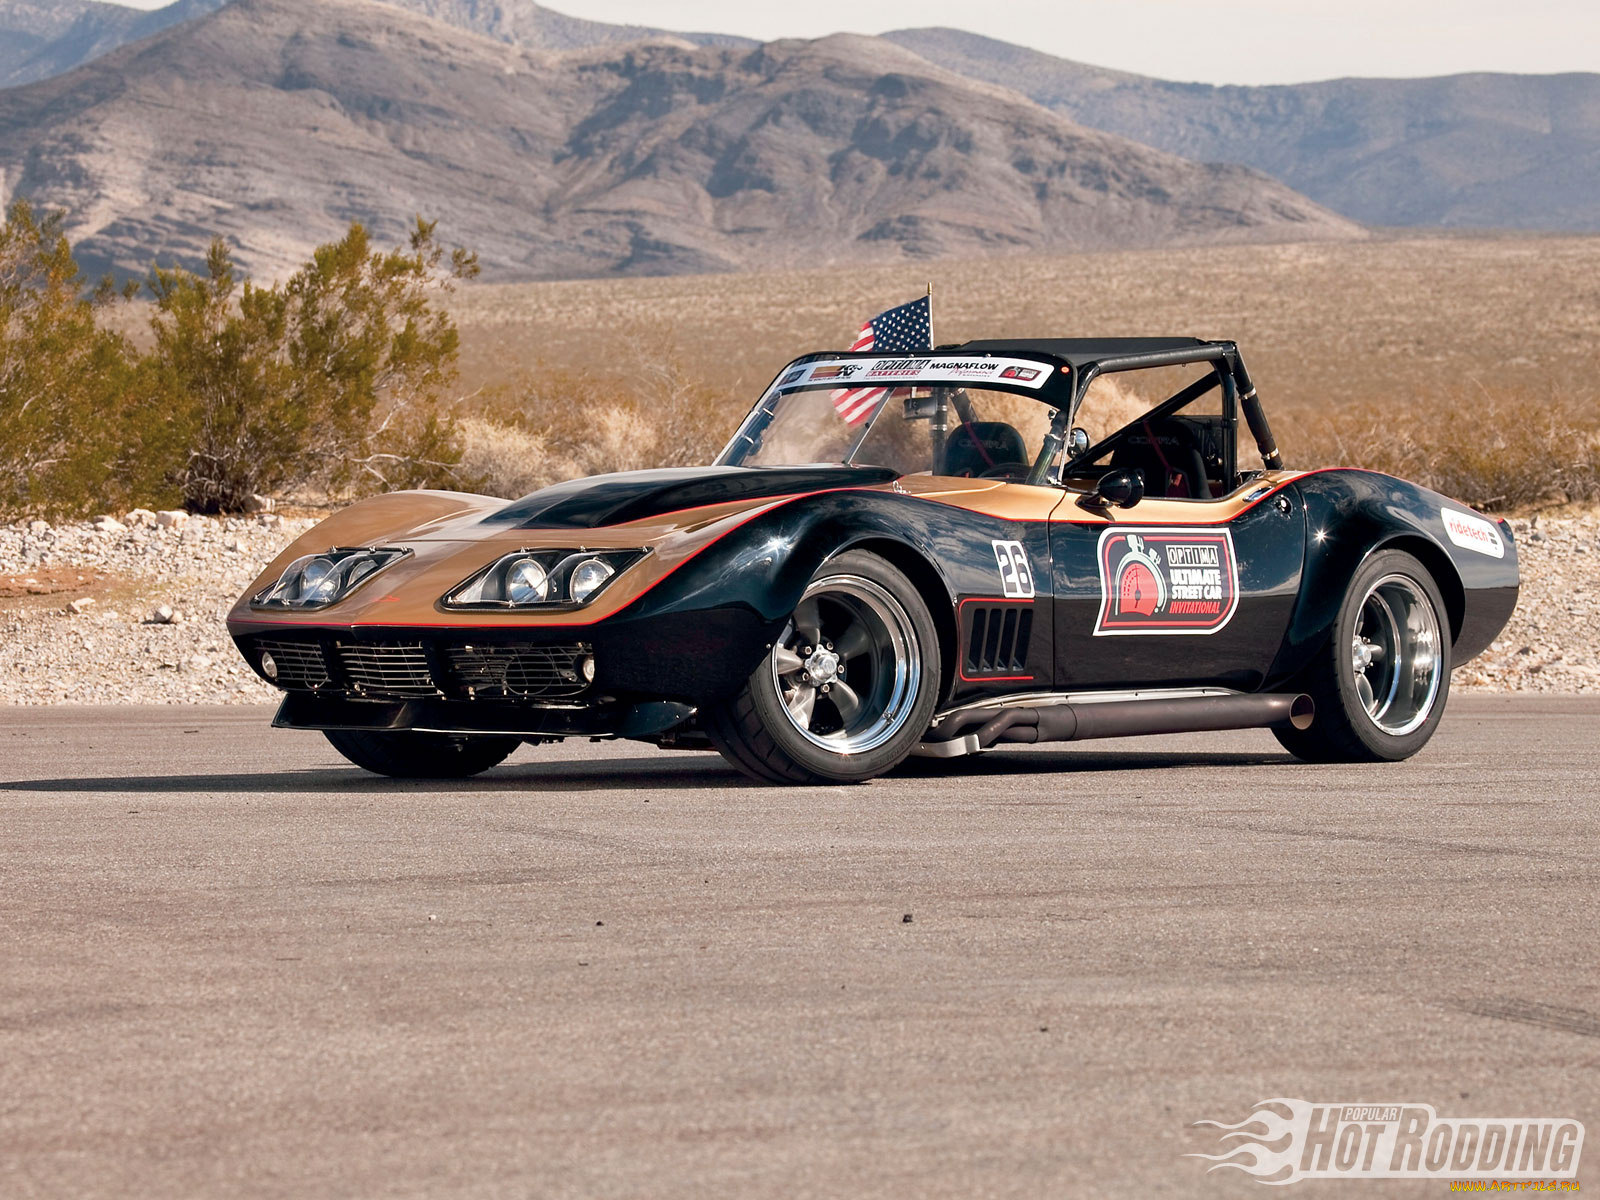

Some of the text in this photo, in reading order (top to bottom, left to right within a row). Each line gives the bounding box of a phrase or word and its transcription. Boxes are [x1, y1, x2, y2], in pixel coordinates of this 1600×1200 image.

[871, 359, 932, 370] OPTIMA
[929, 362, 999, 370] MAGNAFLOW
[1448, 517, 1489, 542] ridetech
[1168, 546, 1219, 566] OPTIMA
[995, 544, 1032, 594] 26
[1169, 568, 1222, 586] ULTIMATE
[1171, 585, 1223, 600] STREET CAR
[1168, 601, 1221, 614] INVITATIONAL
